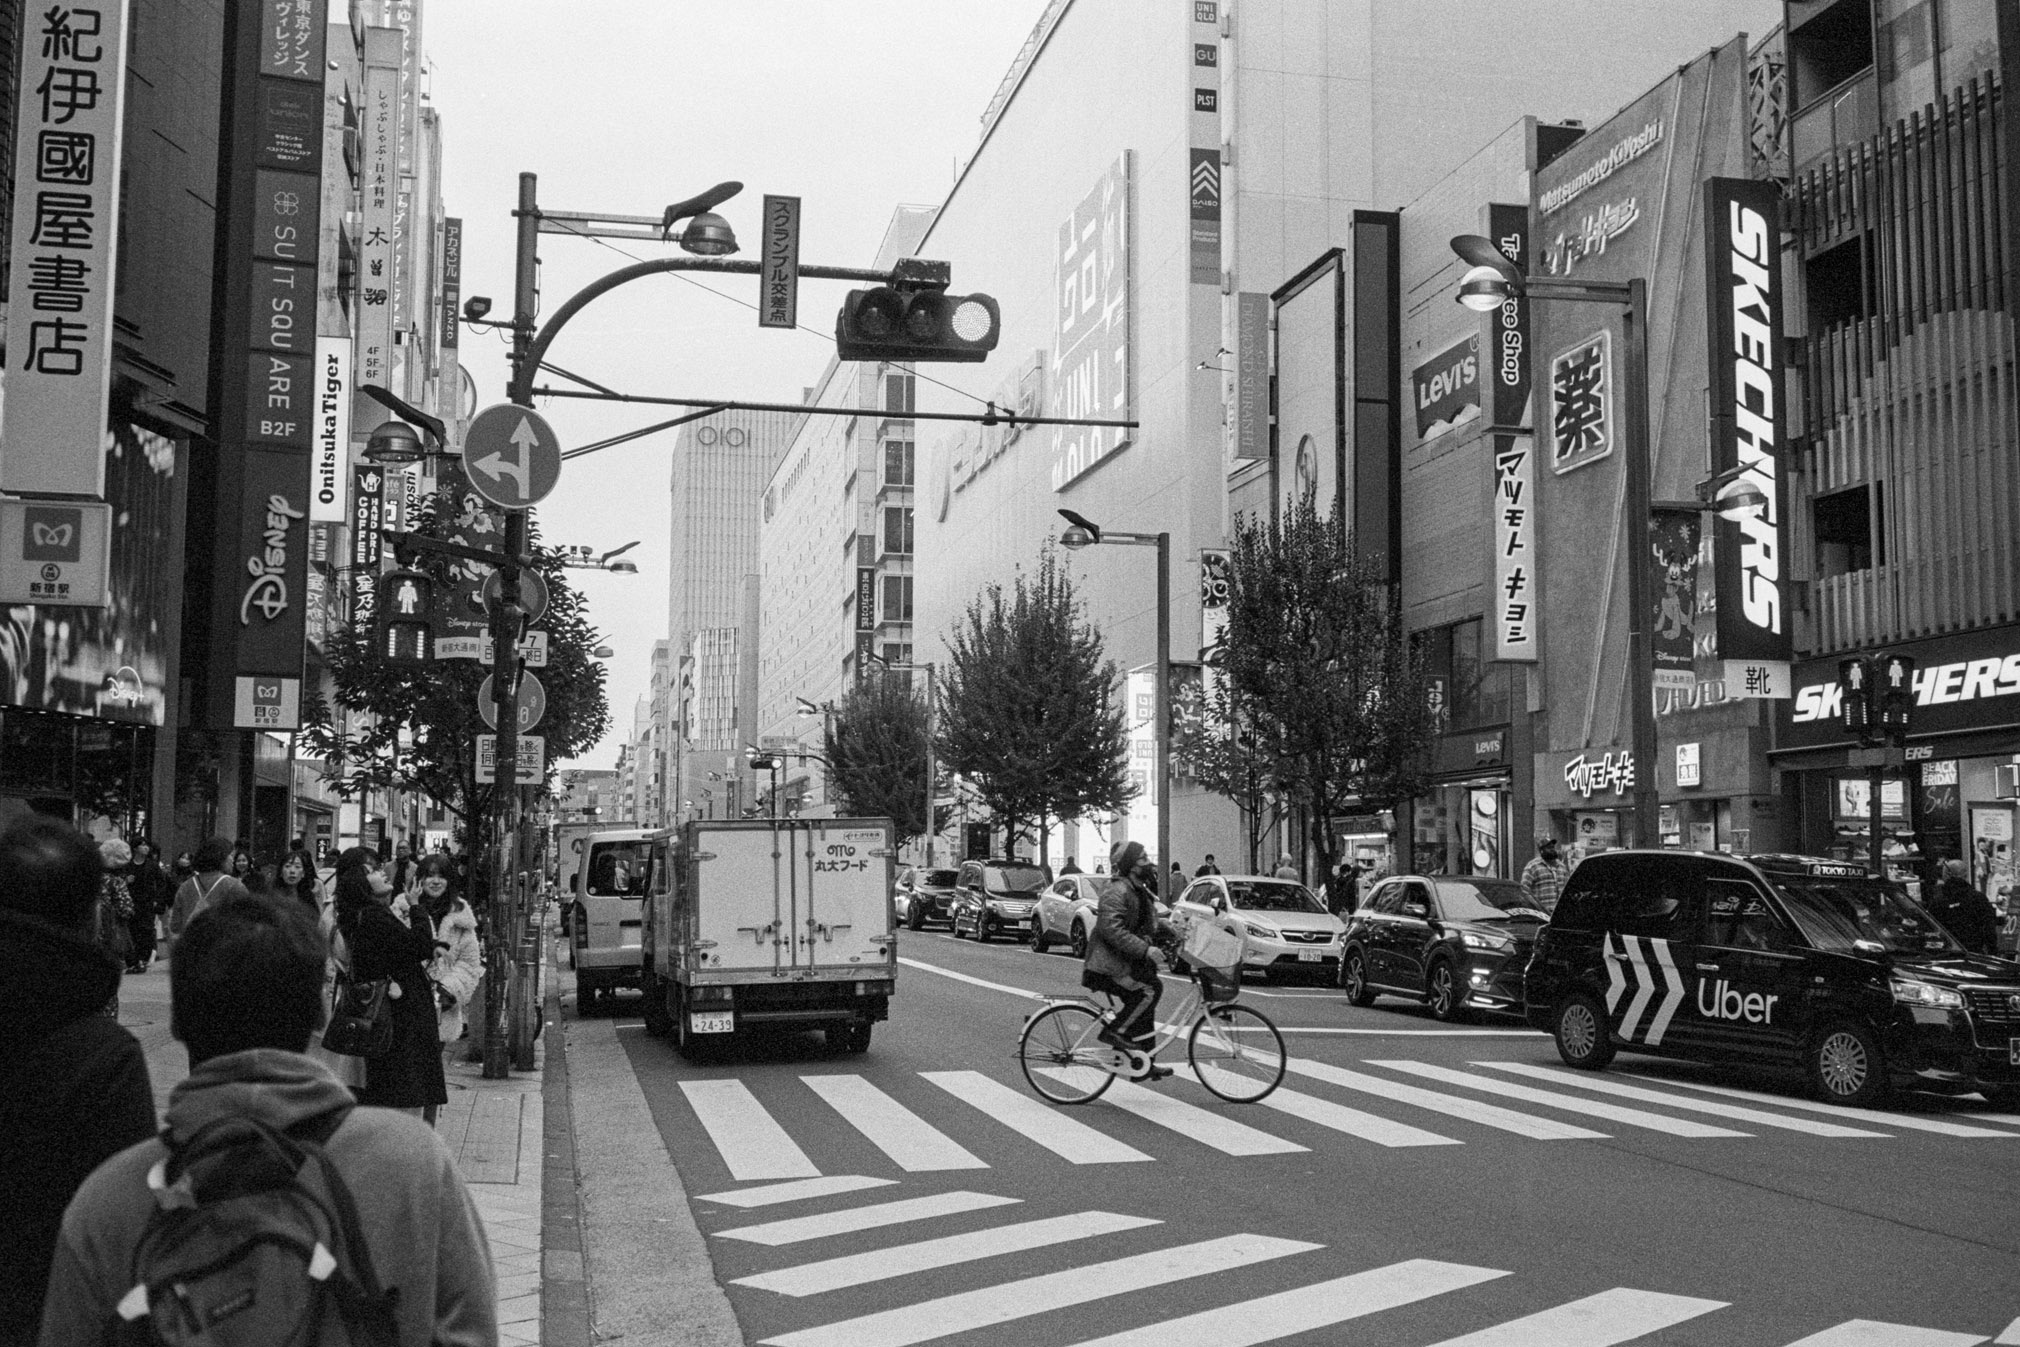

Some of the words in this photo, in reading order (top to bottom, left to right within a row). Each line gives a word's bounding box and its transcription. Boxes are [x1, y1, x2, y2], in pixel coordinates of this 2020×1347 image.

[1197, 3, 1215, 13] UNI
[274, 2, 292, 65] ヴィレッジ
[293, 0, 311, 75] 東京ダンス
[1196, 50, 1216, 61] GU
[1197, 94, 1215, 107] PLST
[24, 5, 102, 376] 紀伊國屋書店
[273, 225, 296, 289] SUIT
[770, 201, 790, 322] スクランブル交差点
[268, 297, 293, 409] SQUARE
[367, 347, 379, 355] 4F
[1242, 303, 1255, 373] DIAMOND
[366, 358, 379, 367] 5F
[366, 369, 379, 378] 6F
[1501, 330, 1522, 385] Shop
[321, 354, 342, 414] Tiger
[260, 420, 296, 437] B2F
[318, 415, 338, 504] Onitsuka
[357, 496, 368, 563] COFFEE
[370, 498, 378, 530] HAND
[241, 494, 304, 625] Disney
[369, 532, 377, 563] DRIP
[1496, 450, 1528, 644] マツモトキヨシ
[30, 582, 69, 594] 新宿駅
[1745, 666, 1771, 695] 靴
[1793, 653, 2020, 722] SKHERS
[1922, 773, 1957, 786] FRIDAY
[1923, 786, 1955, 814] Sale
[814, 859, 868, 873] 丸大フード
[1822, 866, 1847, 875] TOKYO
[1847, 868, 1864, 876] TAXI
[1700, 979, 1779, 1024] Uber
